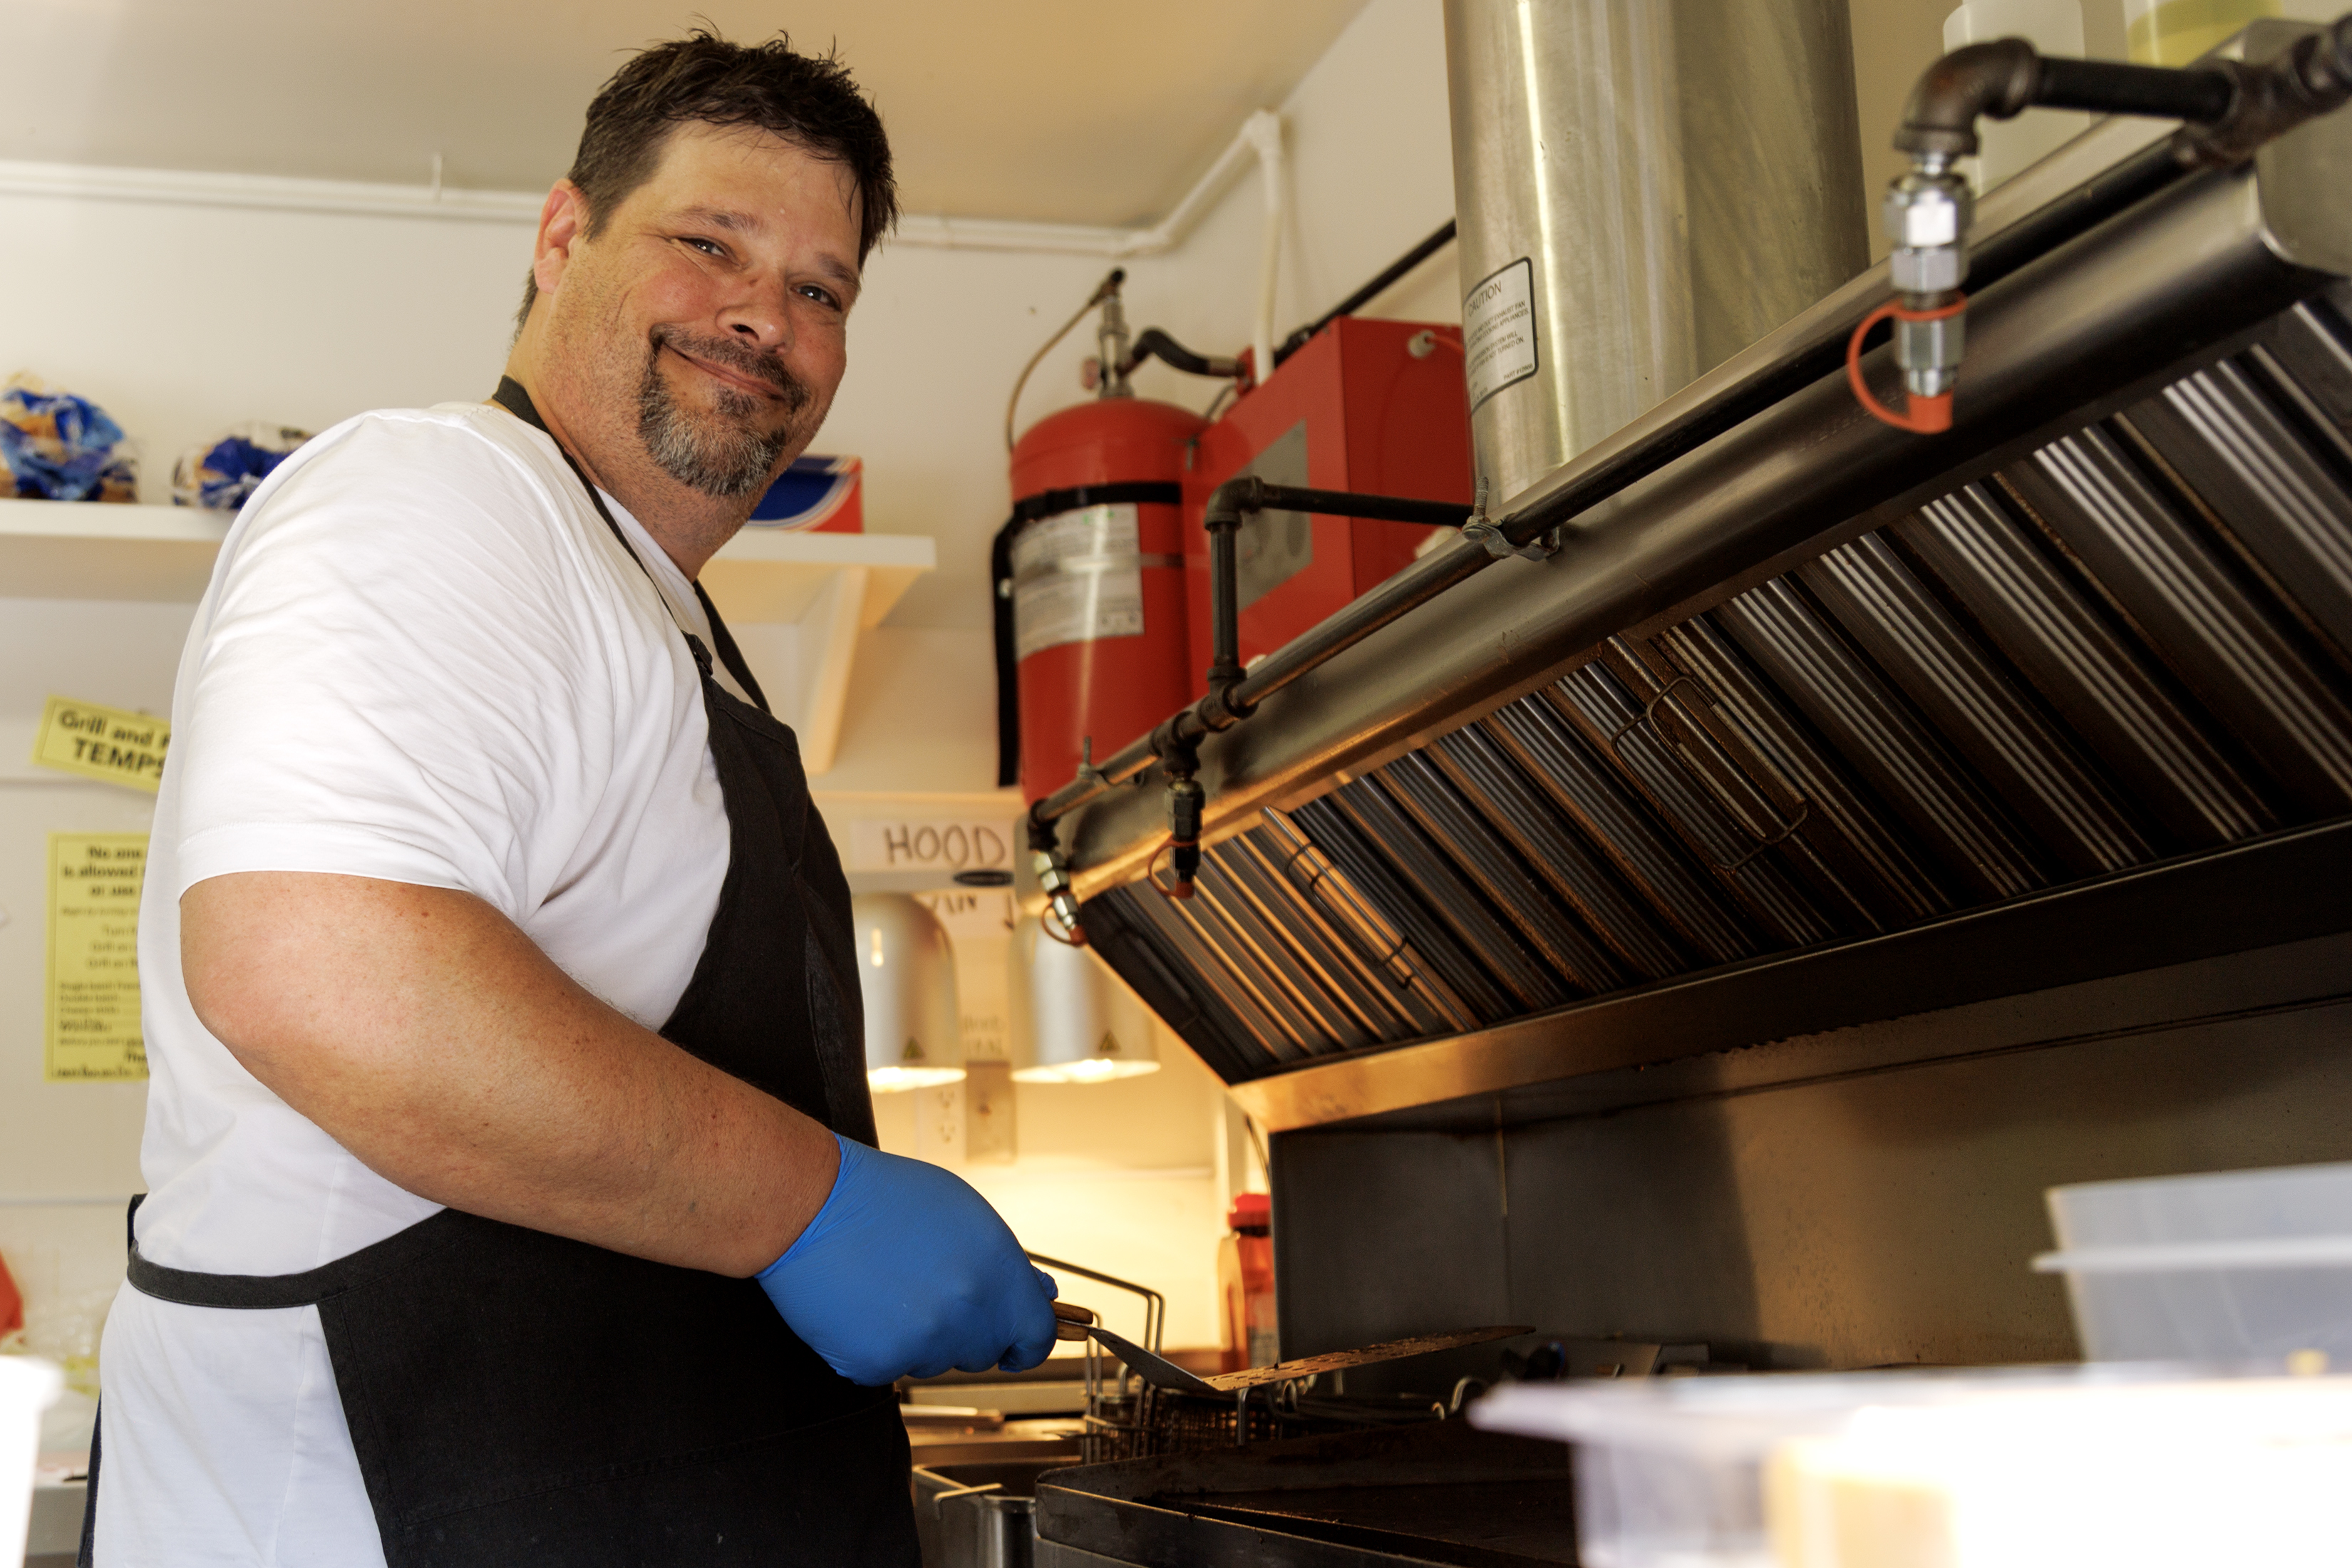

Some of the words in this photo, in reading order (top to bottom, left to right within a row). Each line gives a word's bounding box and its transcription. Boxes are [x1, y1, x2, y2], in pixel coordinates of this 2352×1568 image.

[1468, 280, 1502, 318] CAUTION
[1515, 299, 1525, 310] FAN
[1506, 329, 1518, 341] WILL
[58, 708, 108, 737] Grill
[110, 726, 155, 746] and
[883, 824, 1006, 869] HOOD
[78, 862, 138, 877] allowed
